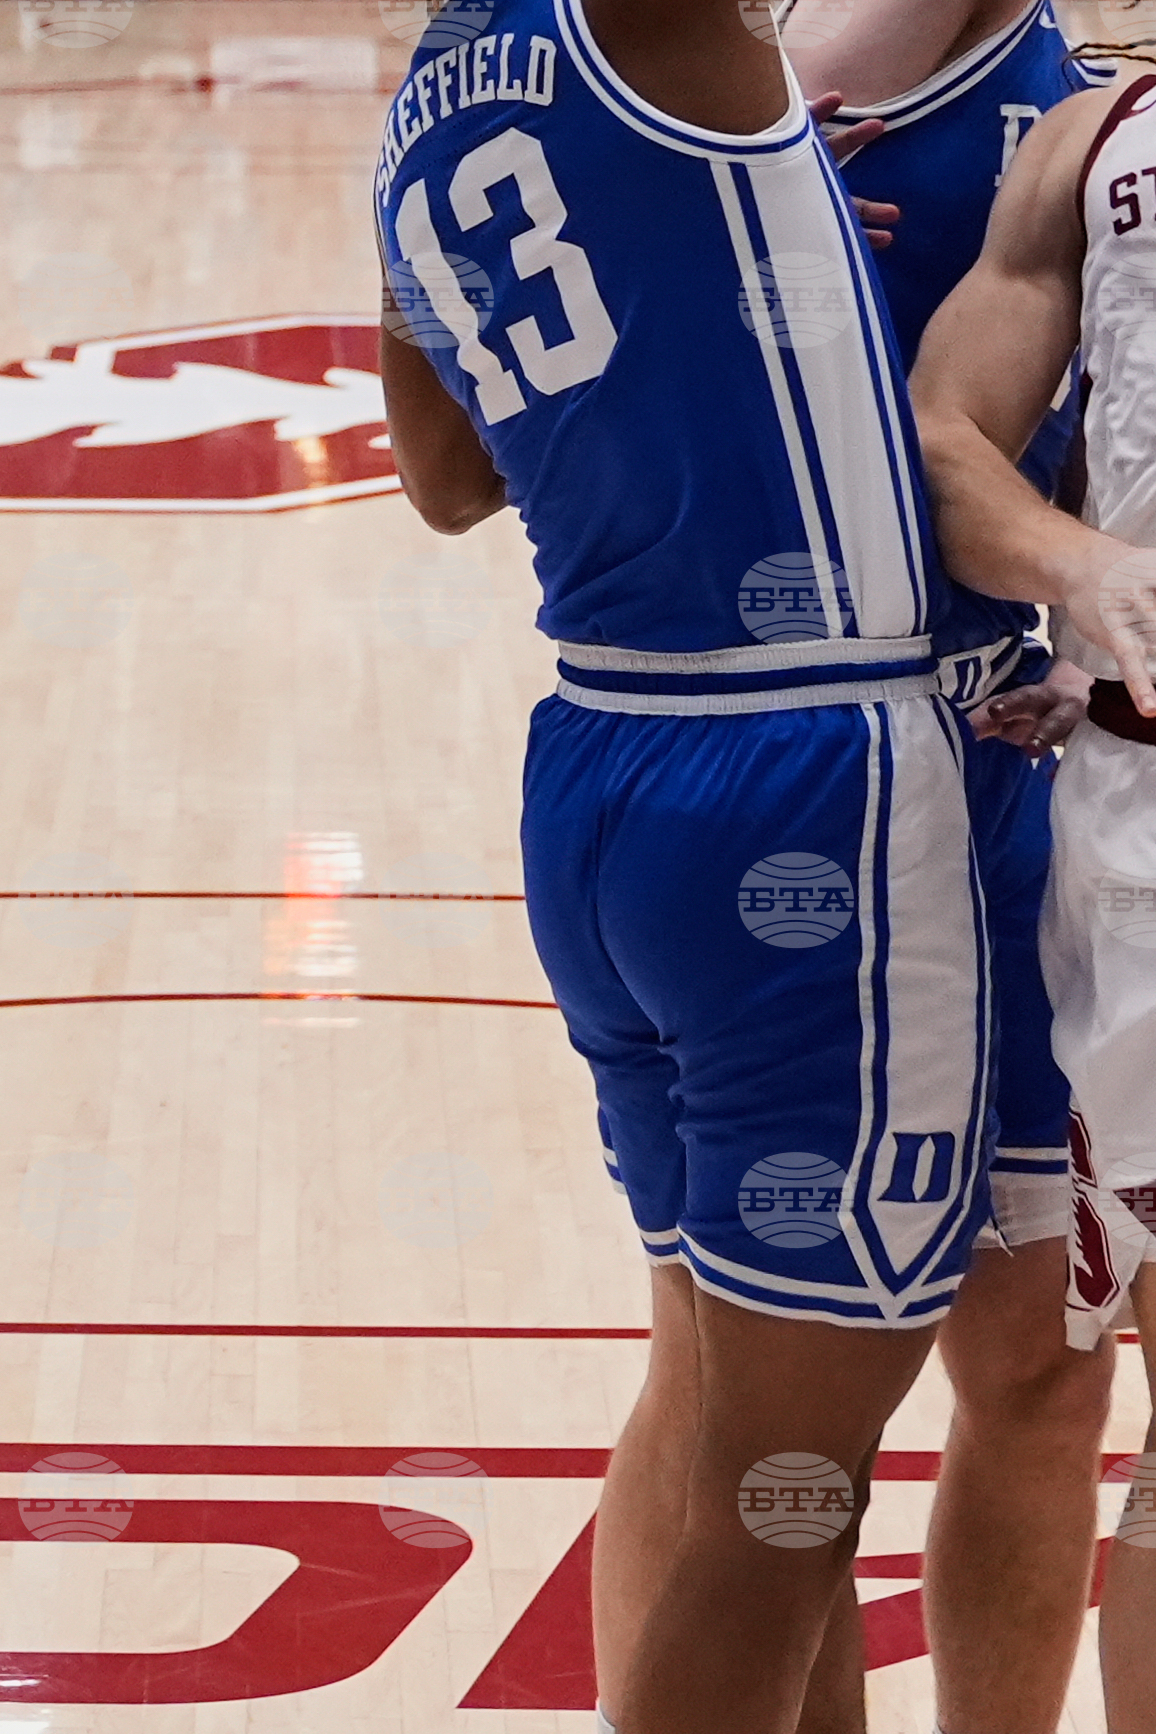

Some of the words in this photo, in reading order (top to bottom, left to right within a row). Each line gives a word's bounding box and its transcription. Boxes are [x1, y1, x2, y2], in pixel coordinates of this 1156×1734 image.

[378, 33, 557, 208] SHEFFIELD
[395, 127, 619, 426] 13
[877, 1131, 956, 1202] D
